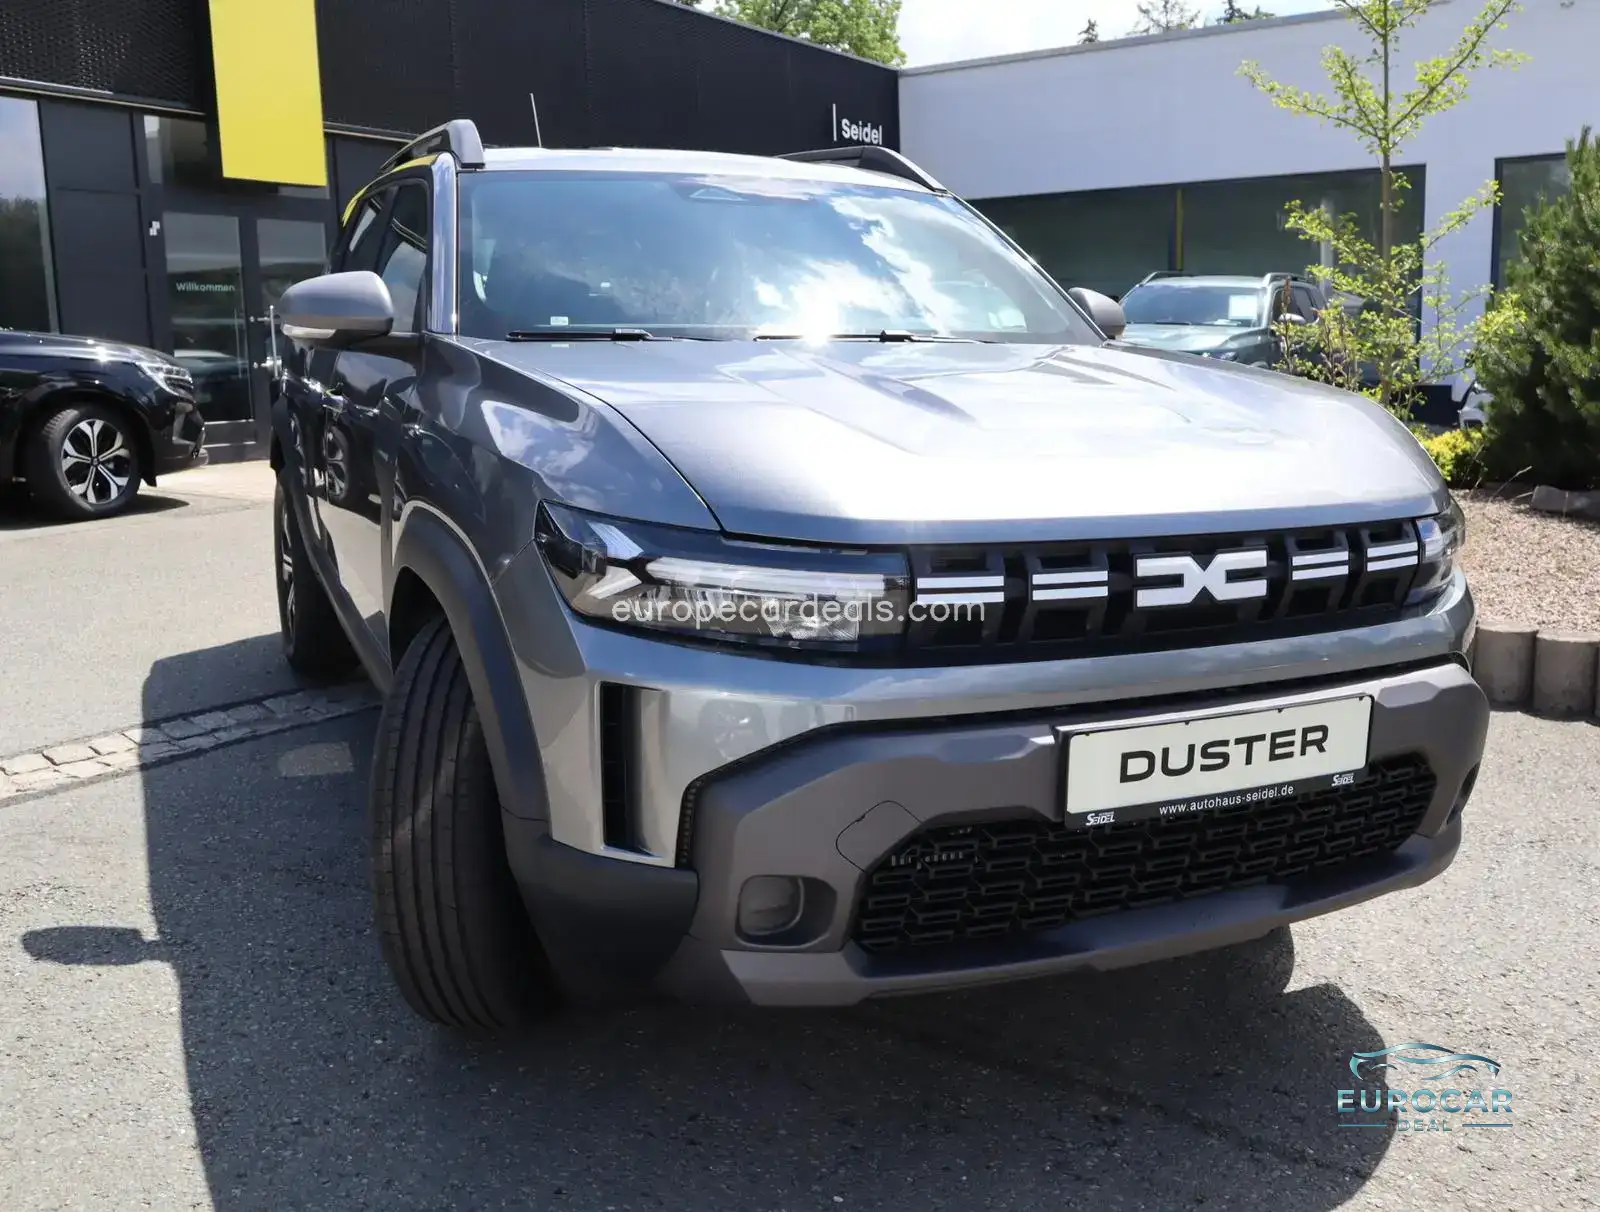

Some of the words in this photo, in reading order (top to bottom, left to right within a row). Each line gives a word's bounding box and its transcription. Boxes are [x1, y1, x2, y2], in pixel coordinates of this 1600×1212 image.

[841, 118, 882, 145] Seidel
[176, 282, 235, 292] Willkommen
[1119, 724, 1329, 783] DUSTER
[1159, 785, 1294, 815] www.autohaus-seidel.de
